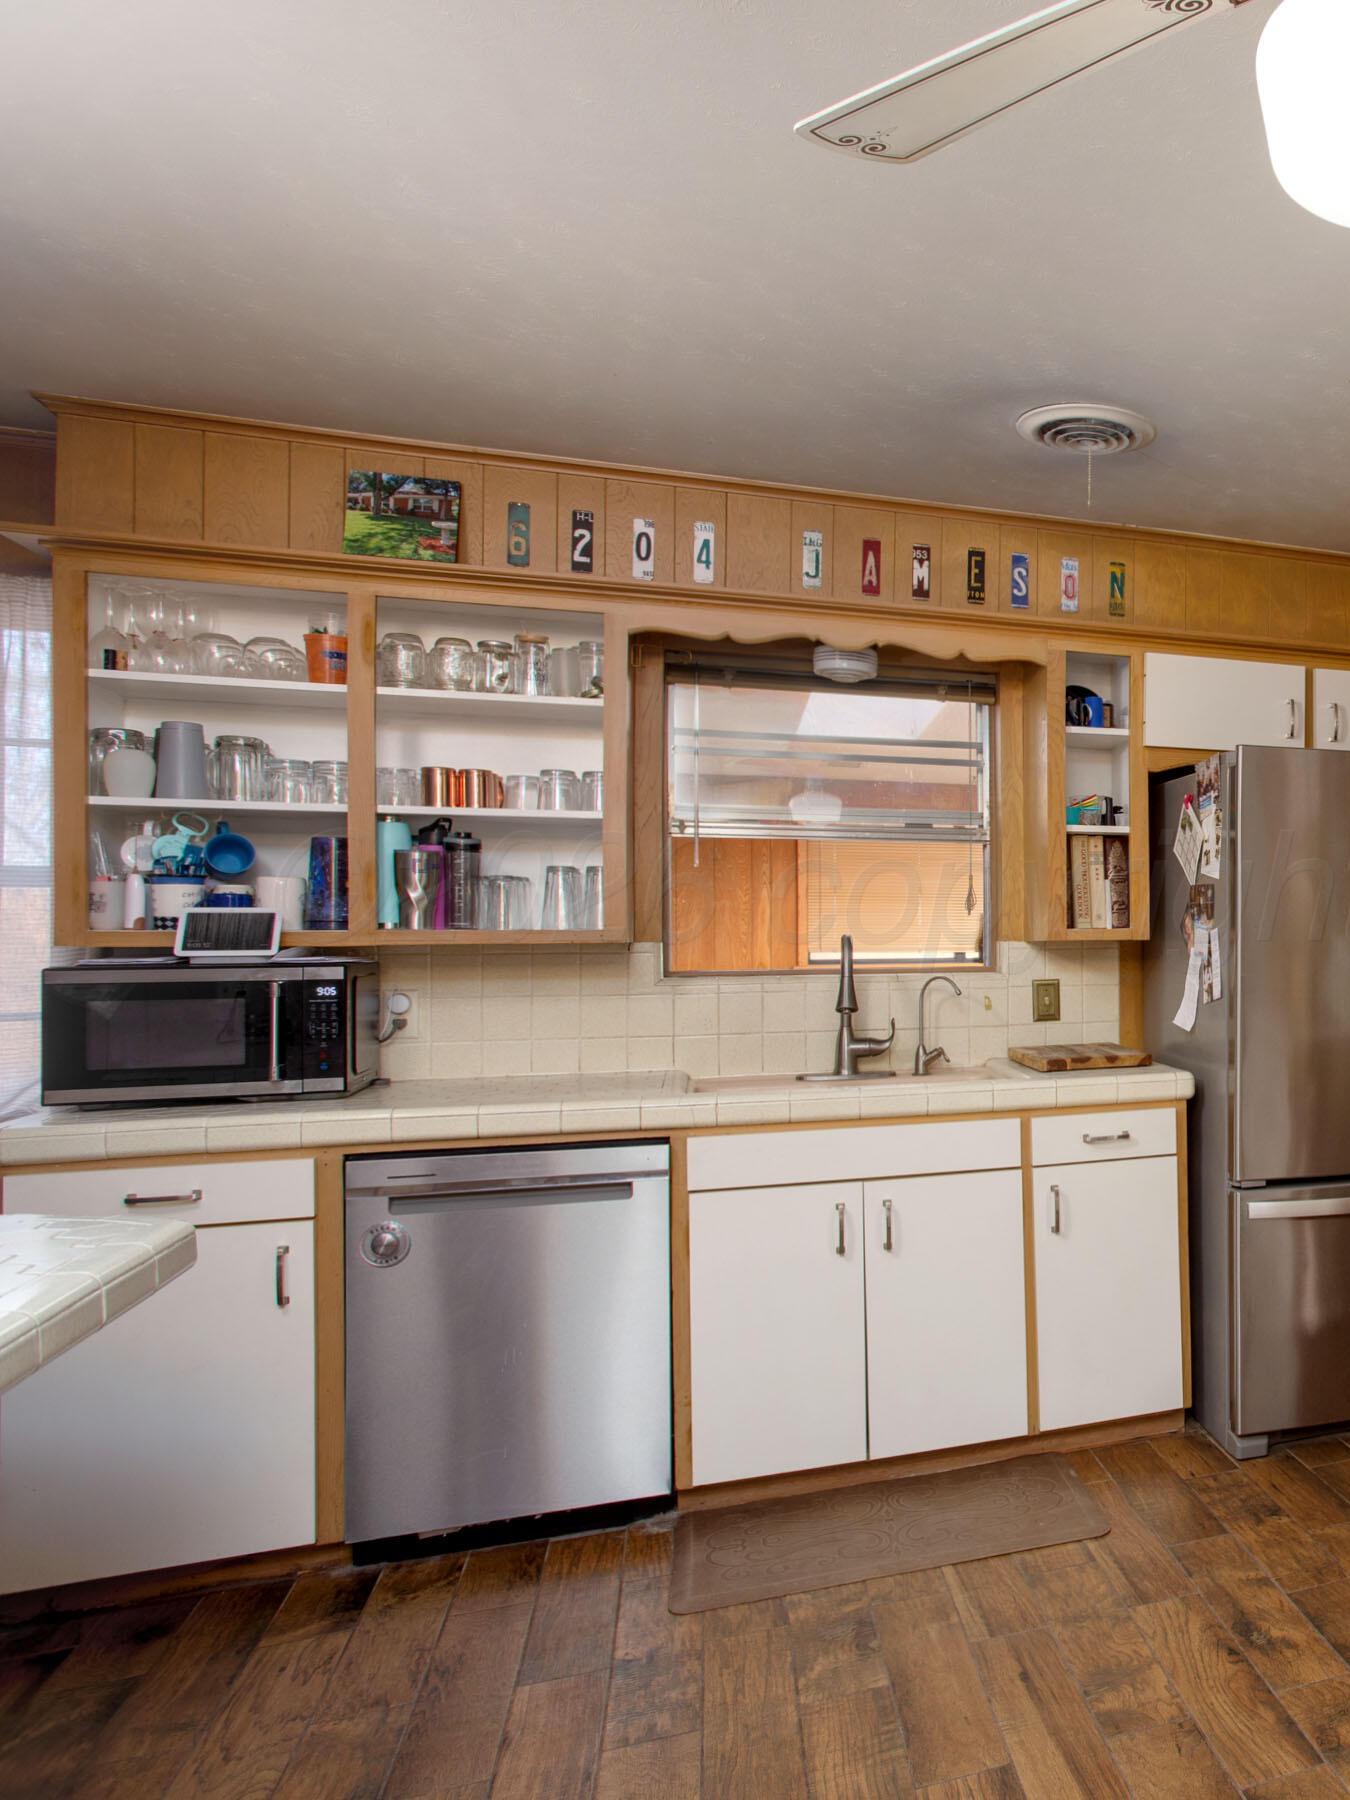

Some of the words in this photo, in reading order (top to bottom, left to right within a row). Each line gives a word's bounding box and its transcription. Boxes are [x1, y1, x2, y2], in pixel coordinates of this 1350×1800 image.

[573, 528, 592, 563] 2
[696, 538, 712, 570] 4
[804, 548, 820, 579] J
[863, 550, 878, 587] A
[912, 560, 930, 592] M
[971, 556, 982, 588] E
[1013, 567, 1027, 597] S
[1110, 570, 1125, 601] N
